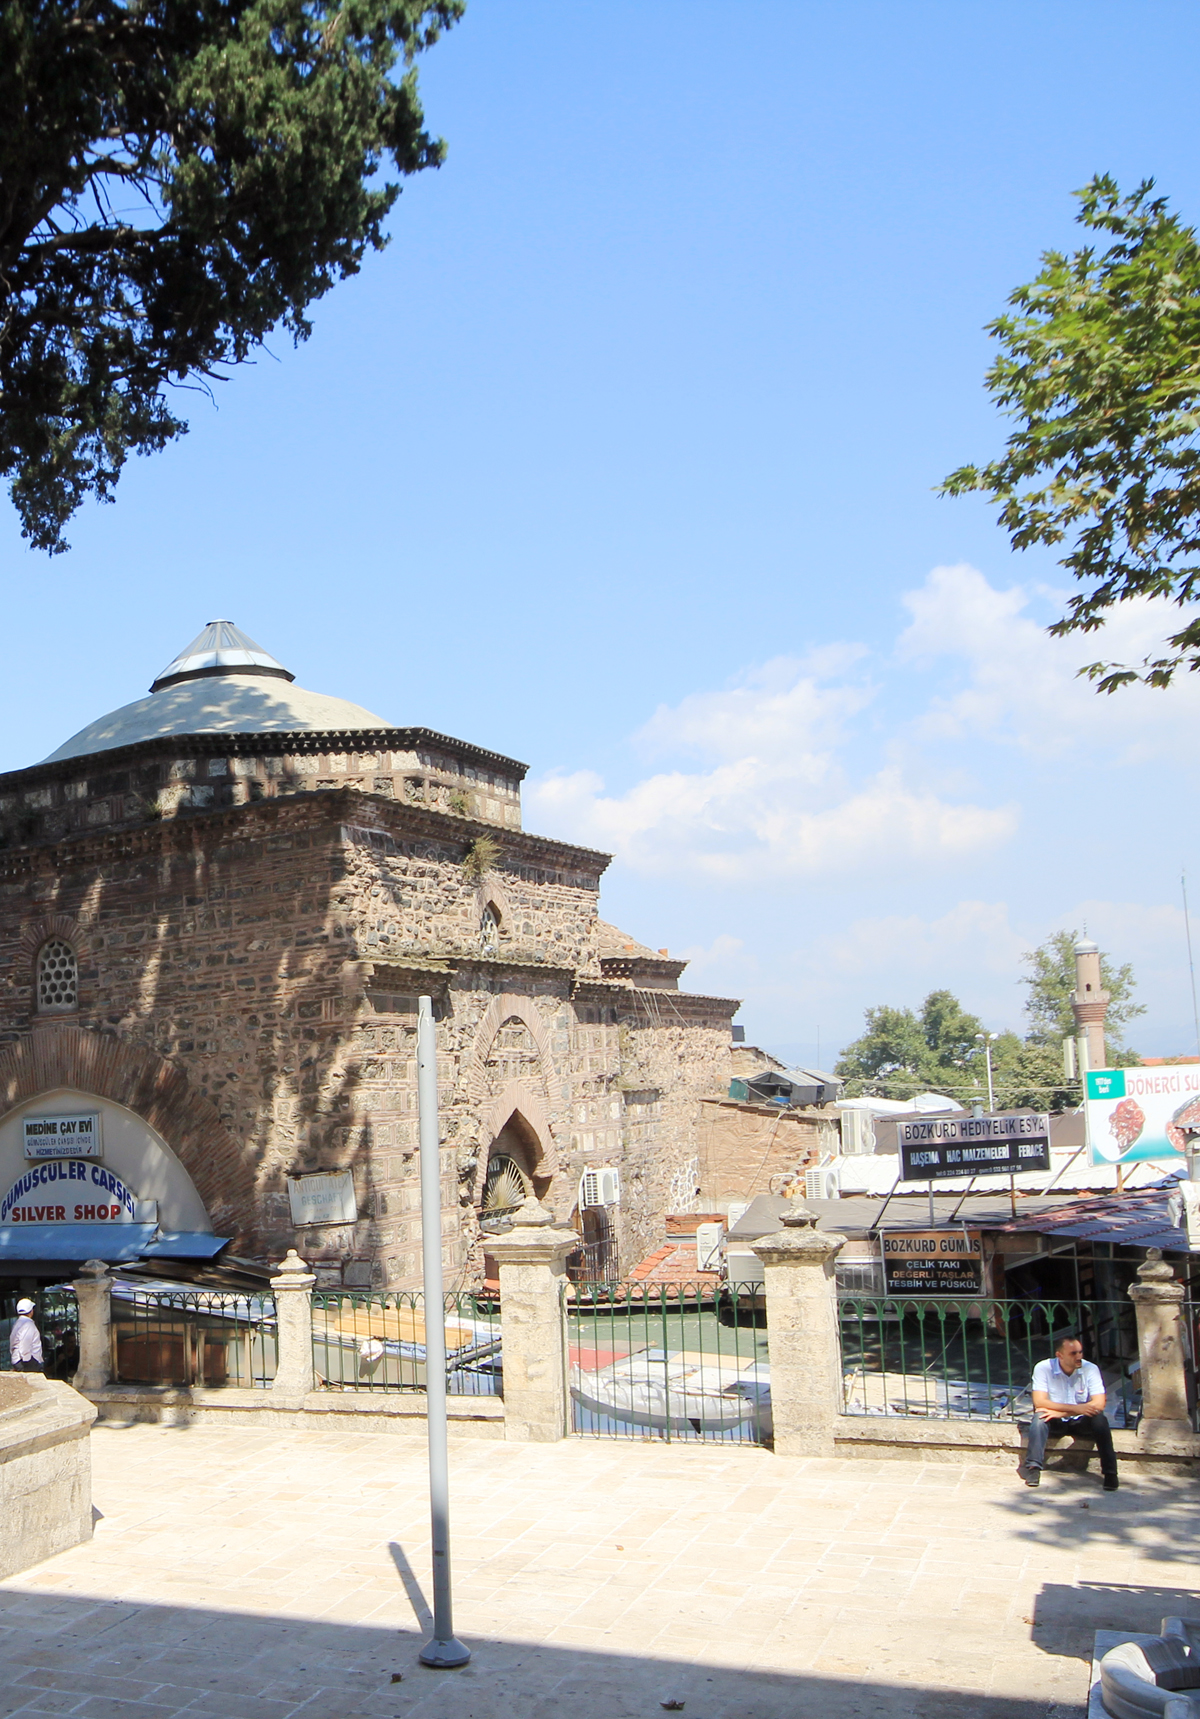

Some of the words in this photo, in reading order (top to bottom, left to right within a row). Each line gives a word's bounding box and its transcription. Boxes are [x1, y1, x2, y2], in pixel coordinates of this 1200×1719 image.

[1184, 1073, 1200, 1092] SU
[26, 1120, 57, 1135] MEDİNE
[60, 1121, 77, 1136] ÇAY
[79, 1117, 92, 1133] EVİ
[905, 1122, 957, 1140] BOZKURD
[910, 1150, 940, 1167] HAŞEMA
[946, 1149, 961, 1163] HAC
[1018, 1143, 1044, 1158] FERACE
[11, 1205, 66, 1222] SILVER
[74, 1204, 121, 1220] SHOP
[884, 1239, 936, 1253] BOZKURD
[906, 1260, 935, 1269] ÇELİK
[938, 1260, 960, 1269] TAKI
[888, 1278, 922, 1288] TESBİH
[925, 1280, 938, 1288] VE
